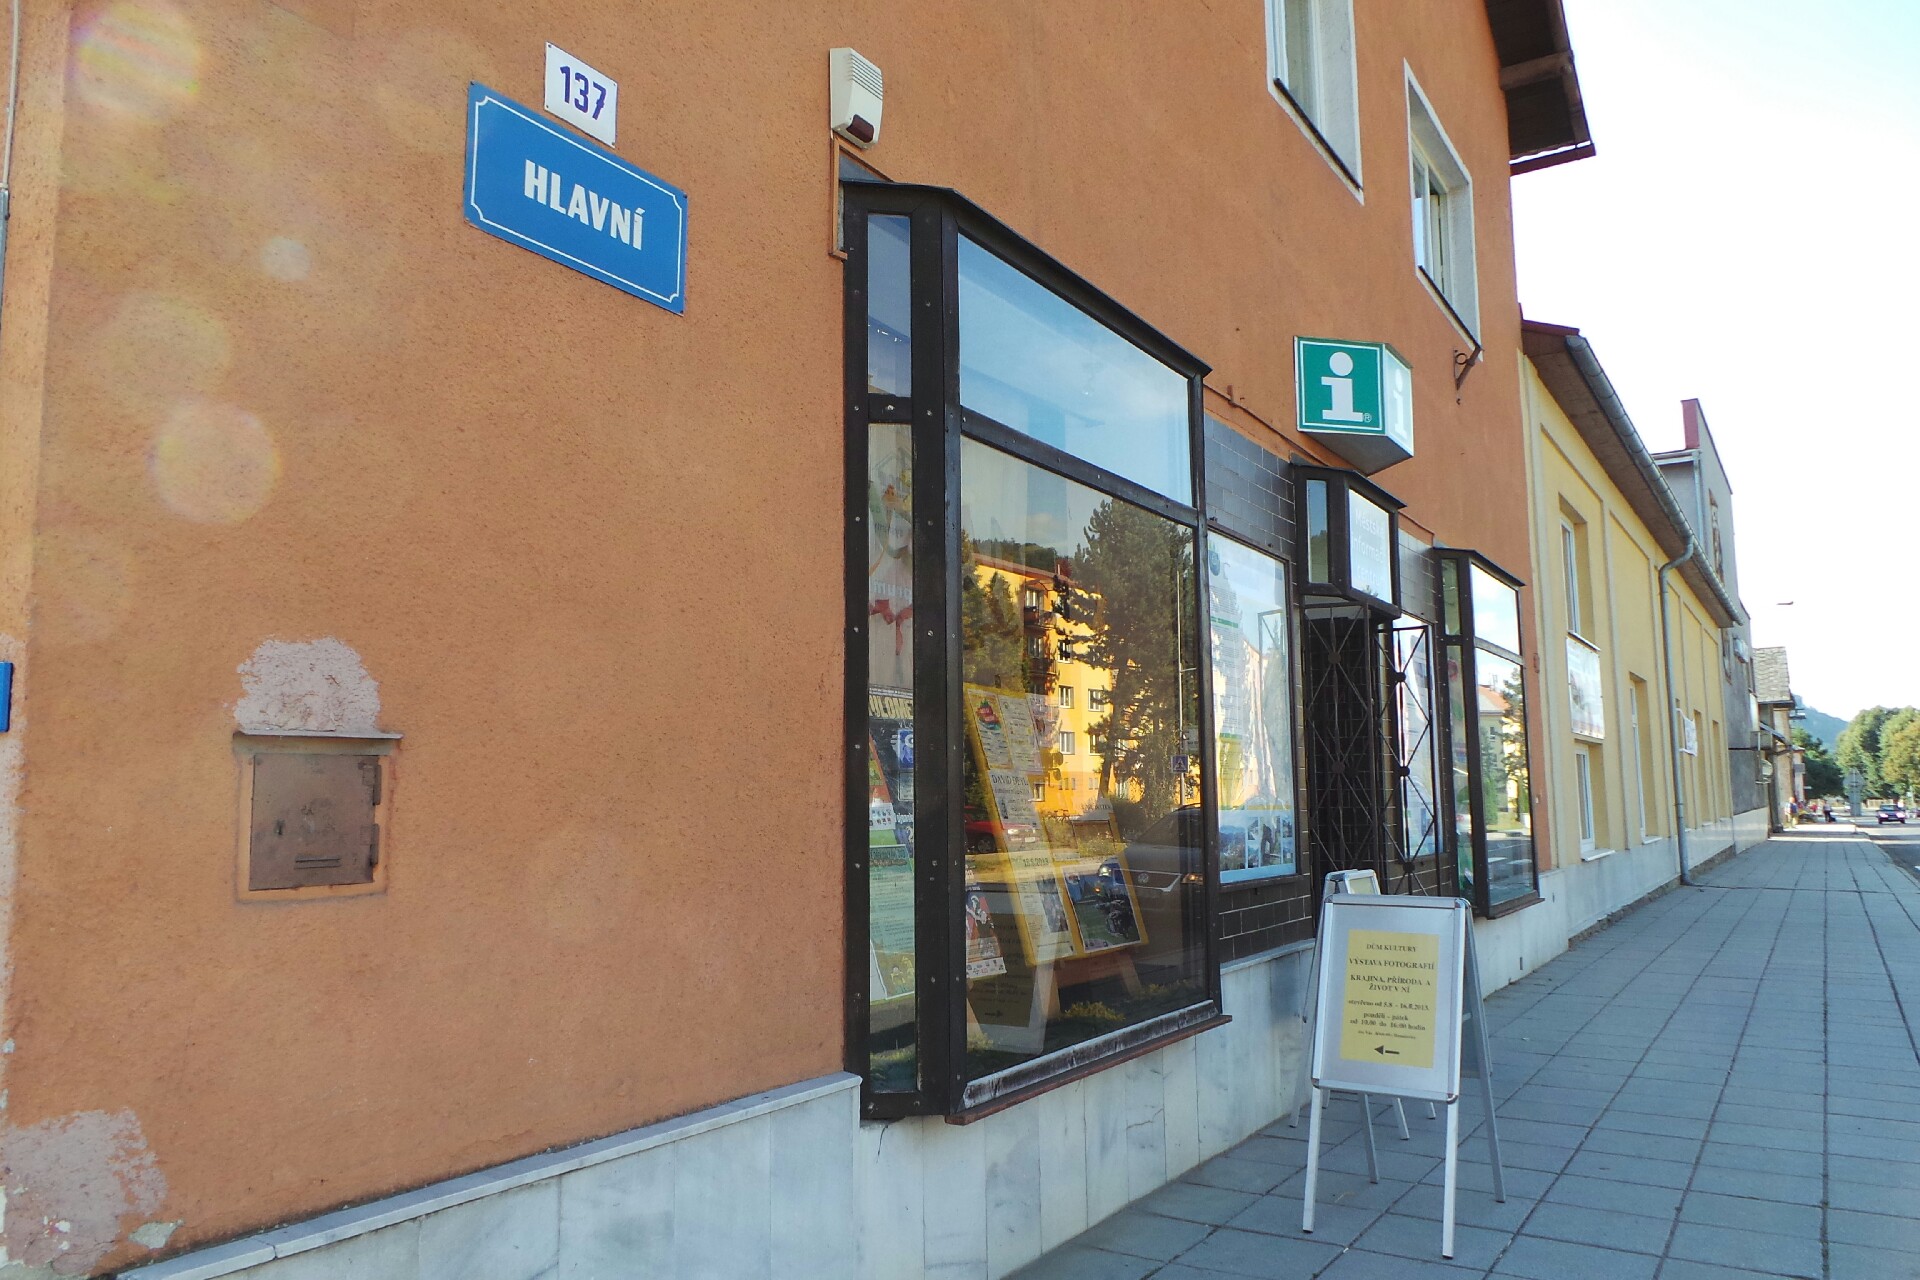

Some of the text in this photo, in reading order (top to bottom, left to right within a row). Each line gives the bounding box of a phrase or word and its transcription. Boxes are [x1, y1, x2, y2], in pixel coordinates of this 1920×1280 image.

[559, 66, 607, 120] 137
[524, 159, 645, 250] HLAVNÍ
[1366, 942, 1416, 953] DŮM KULTURY
[1349, 956, 1435, 970] VÝSTAVA FOTOGRAFIÍ
[1387, 975, 1422, 986] PŘÍRODA
[1369, 982, 1392, 992] ŽIVOT
